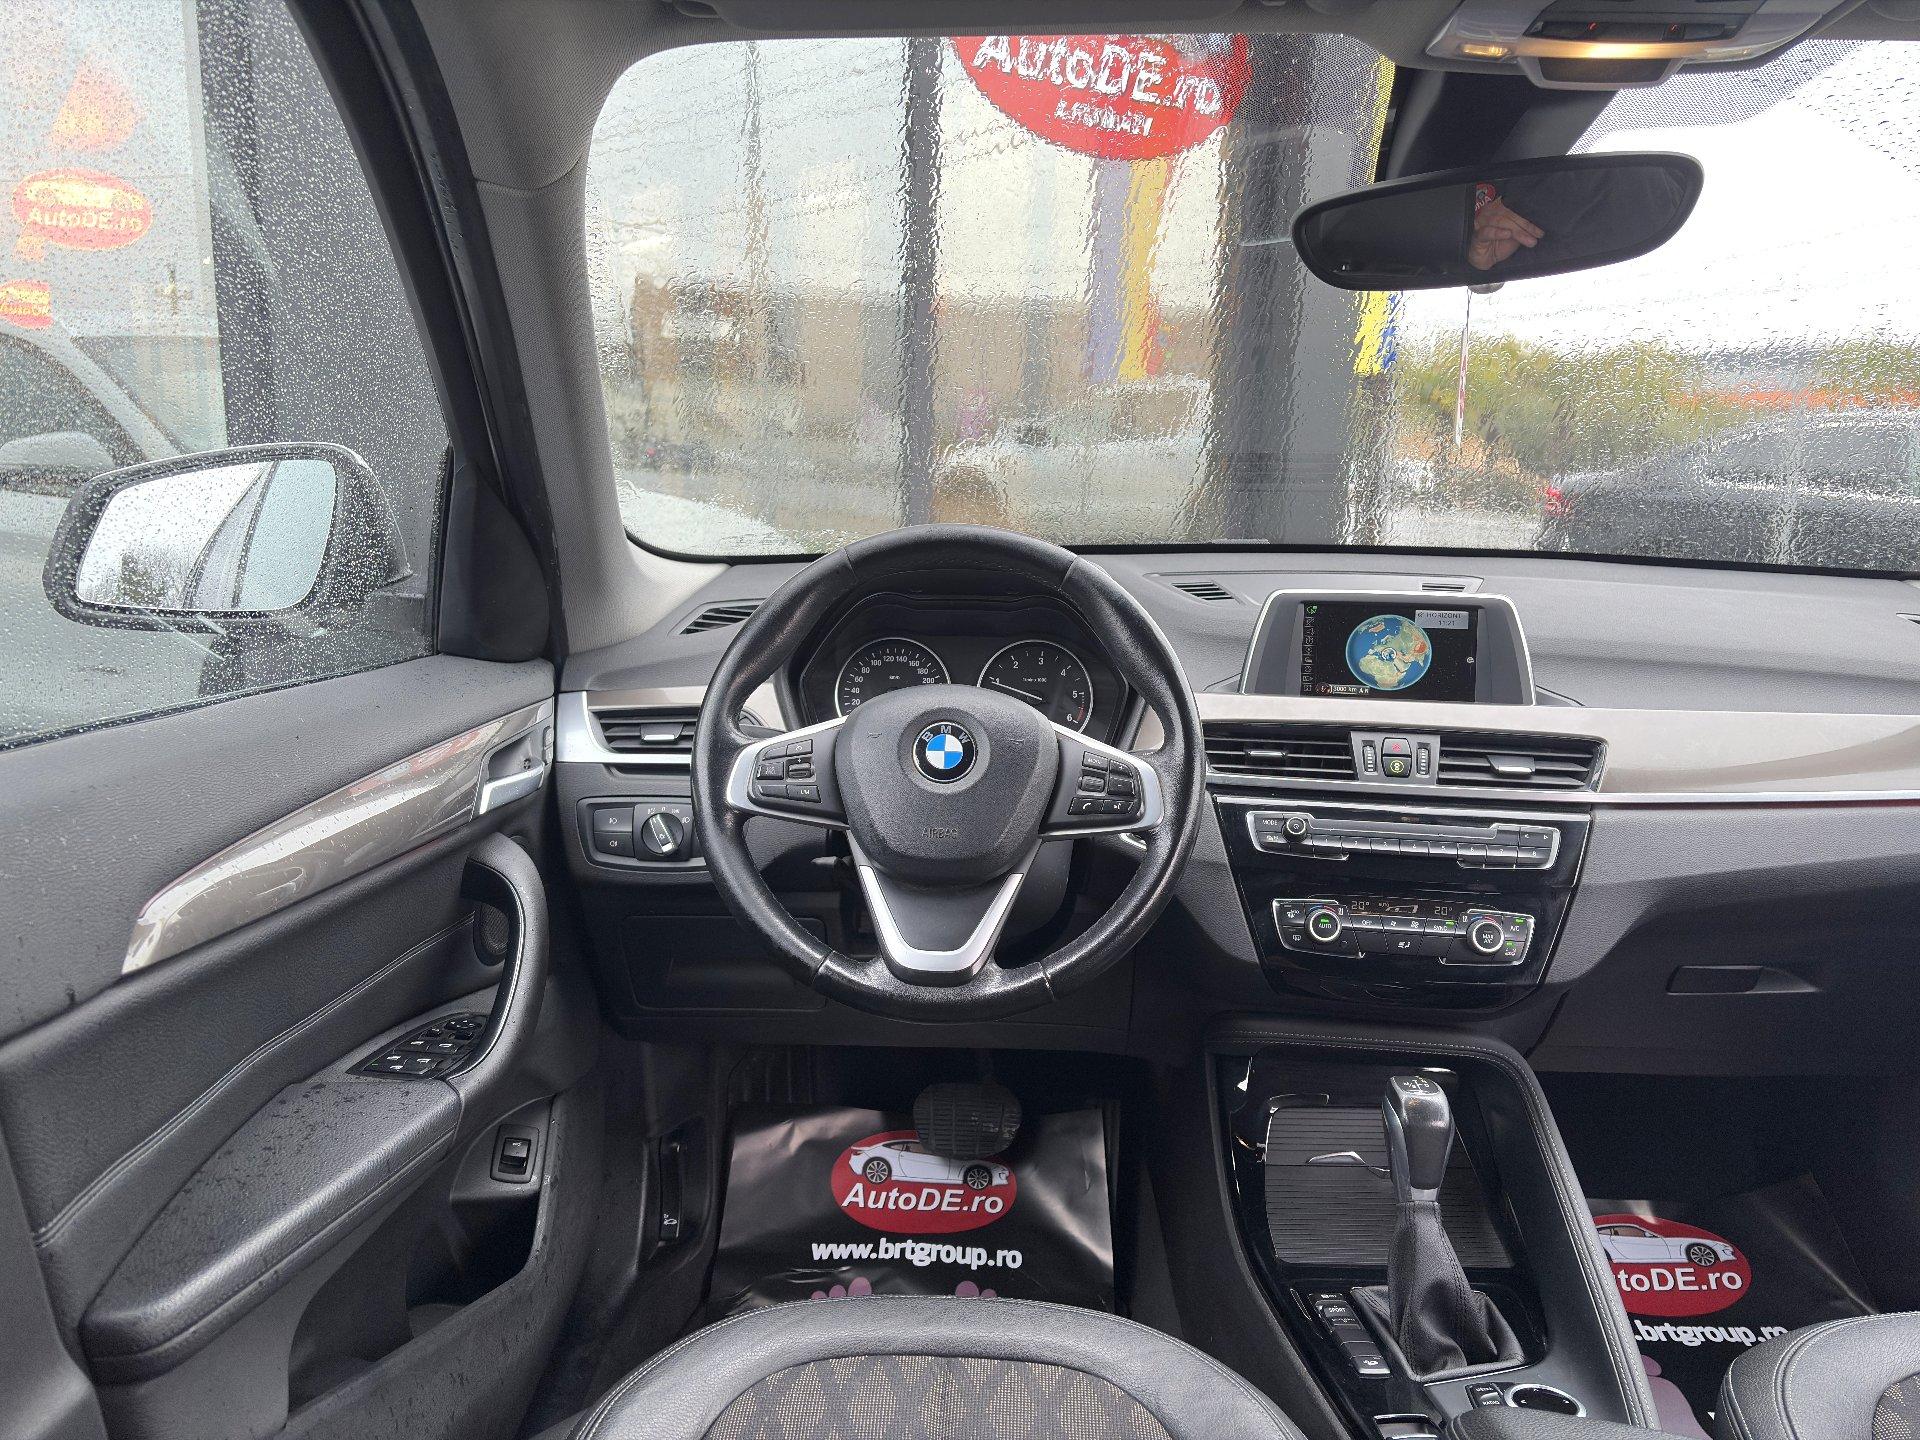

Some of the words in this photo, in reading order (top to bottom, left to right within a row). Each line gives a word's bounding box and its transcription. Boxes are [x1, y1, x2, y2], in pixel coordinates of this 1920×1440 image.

[27, 207, 142, 232] AutoDE.ro
[871, 659, 882, 667] 100
[883, 655, 895, 663] 120
[896, 655, 908, 663] 140
[1038, 657, 1044, 666] 3
[1013, 660, 1019, 669] 2
[861, 666, 870, 674] 80
[917, 667, 929, 675] 180
[1060, 668, 1066, 677] 4
[854, 675, 864, 683] 60
[1072, 690, 1078, 699] 5
[1066, 713, 1073, 722] 6
[921, 724, 971, 744] BMW
[921, 828, 958, 839] AIRBAG
[841, 1182, 1004, 1214] AutoDE.ro
[811, 1237, 1023, 1271] www.brtgroup.ro
[1612, 1267, 1743, 1292] toDE.ro
